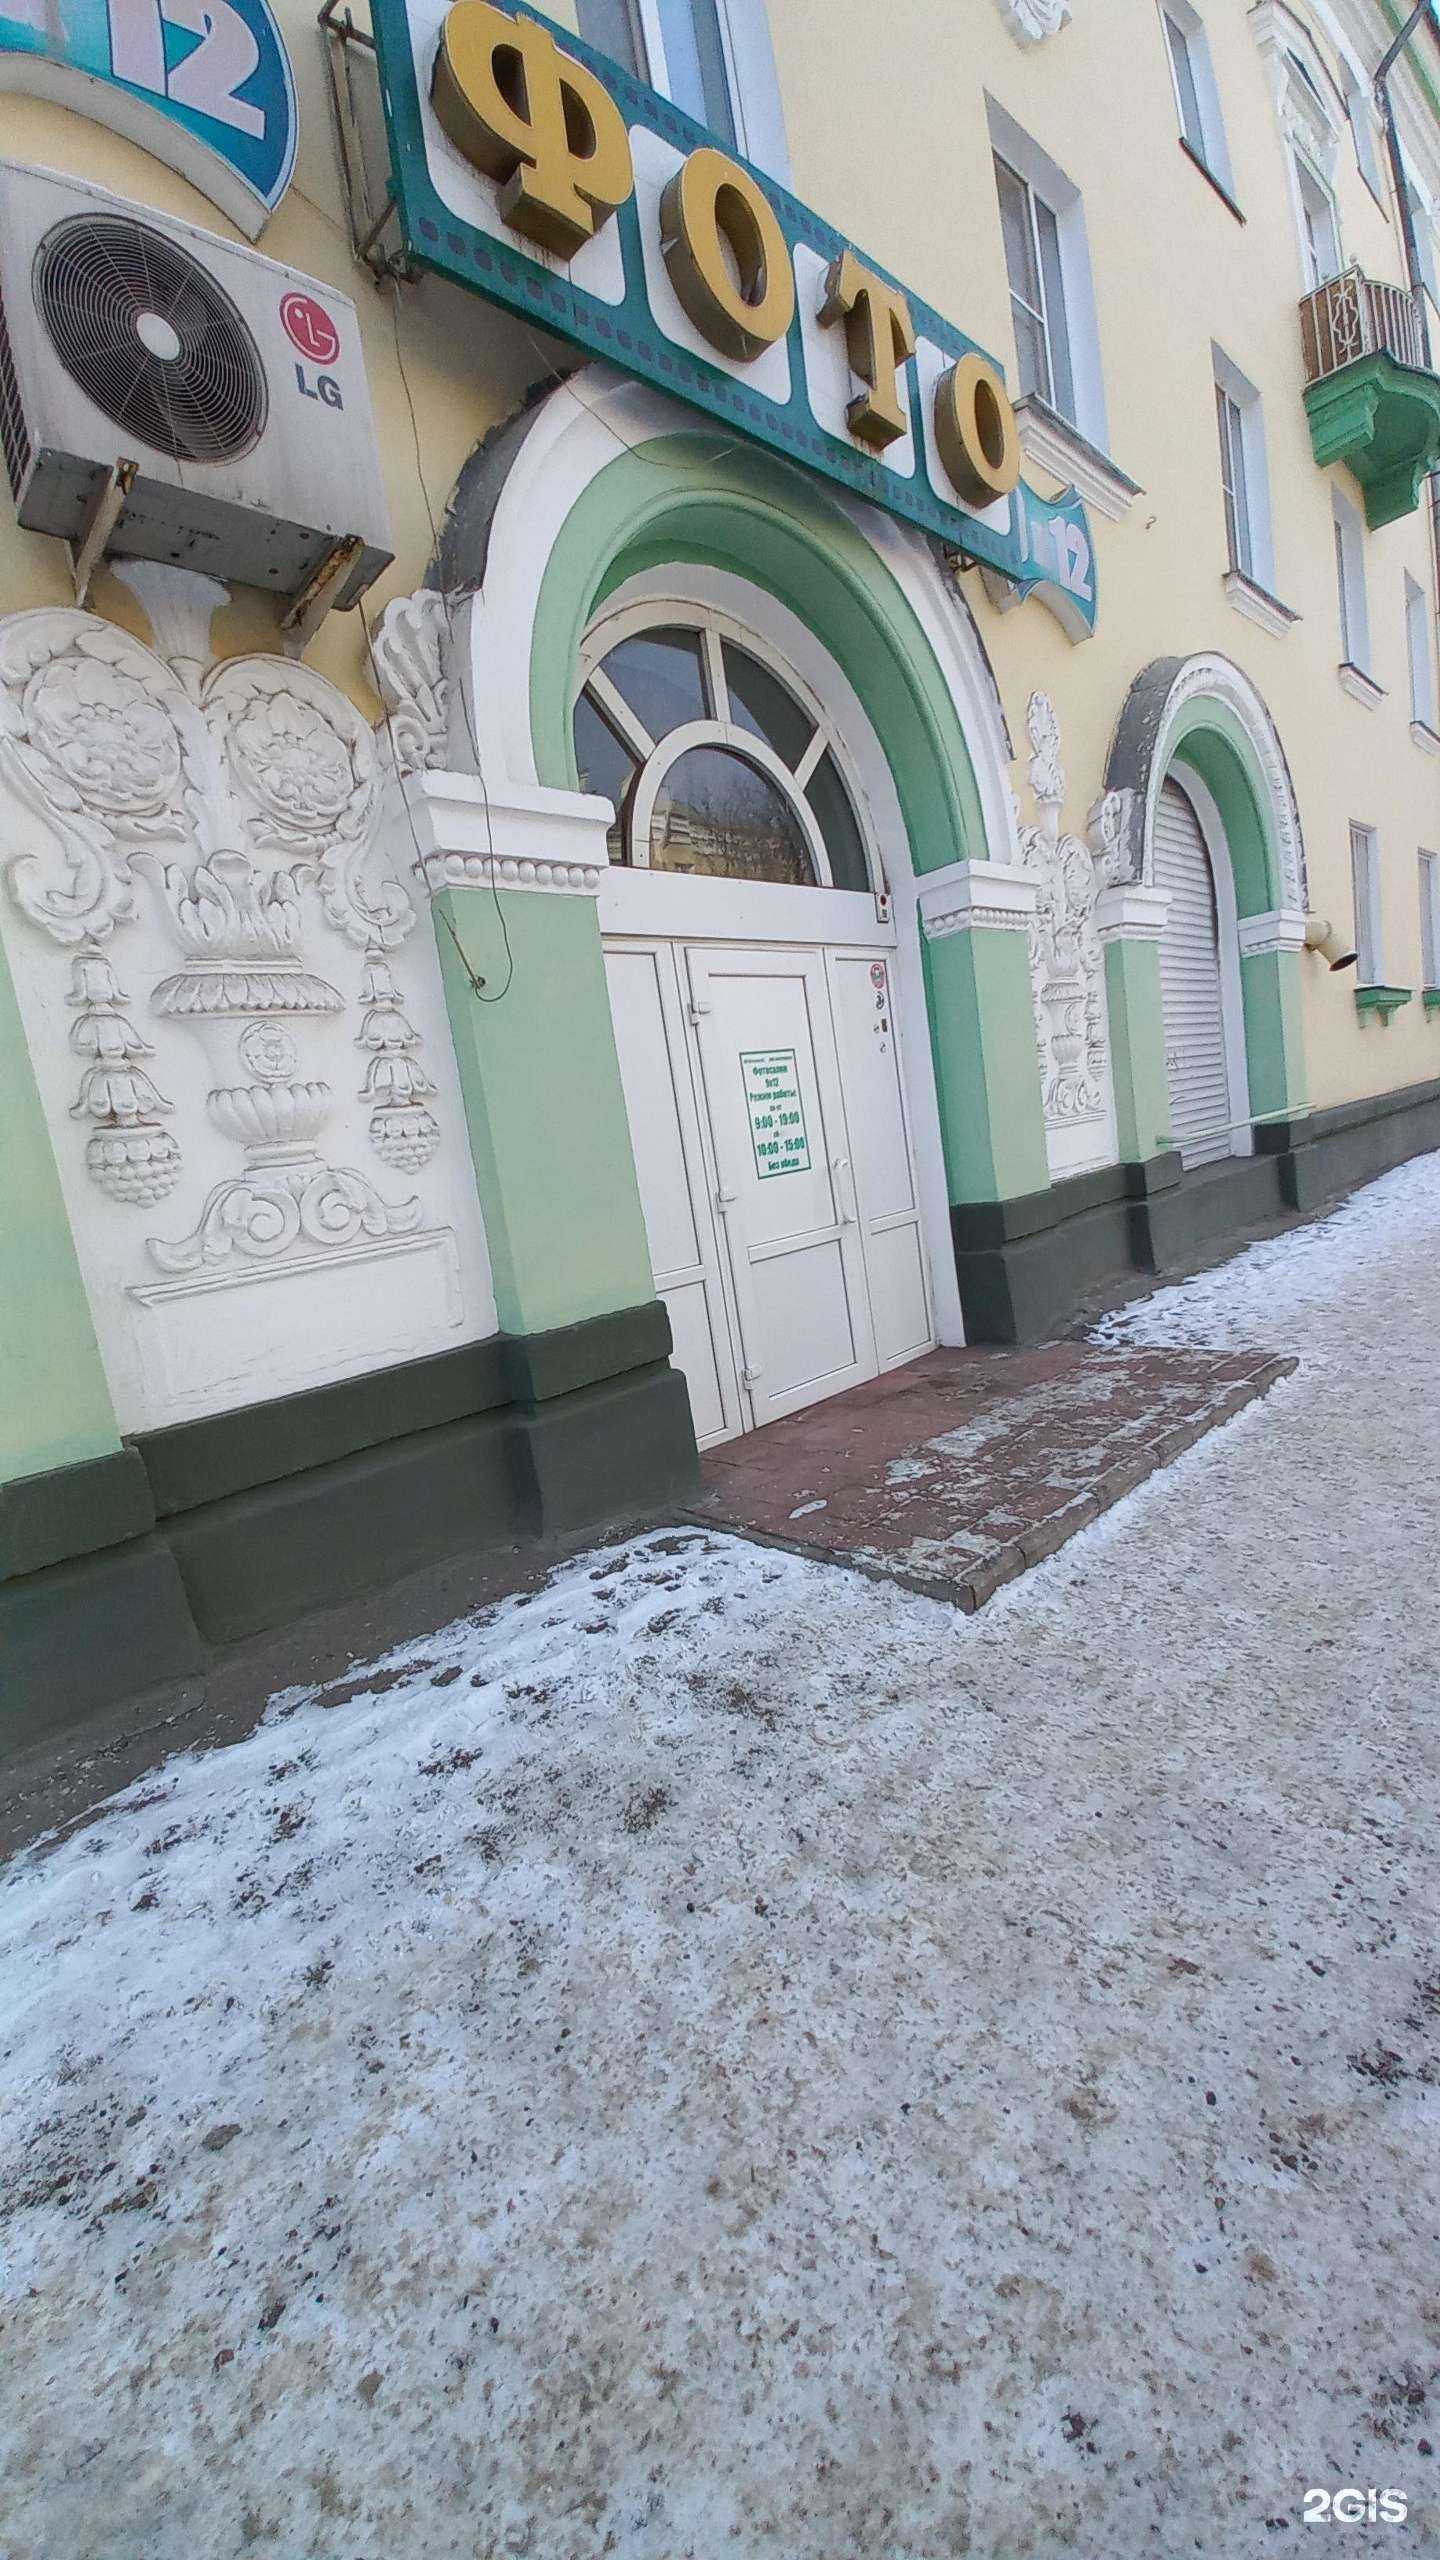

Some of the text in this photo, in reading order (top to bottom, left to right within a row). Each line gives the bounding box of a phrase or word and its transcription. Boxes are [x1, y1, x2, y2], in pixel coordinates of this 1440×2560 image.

[432, 0, 1020, 508] ФОТО
[295, 363, 343, 411] LG
[1049, 516, 1092, 602] 12
[754, 1115, 773, 1129] 9:00
[779, 1111, 800, 1126] 19:00
[757, 1141, 779, 1156] 10:00
[784, 1137, 805, 1152] 15:00
